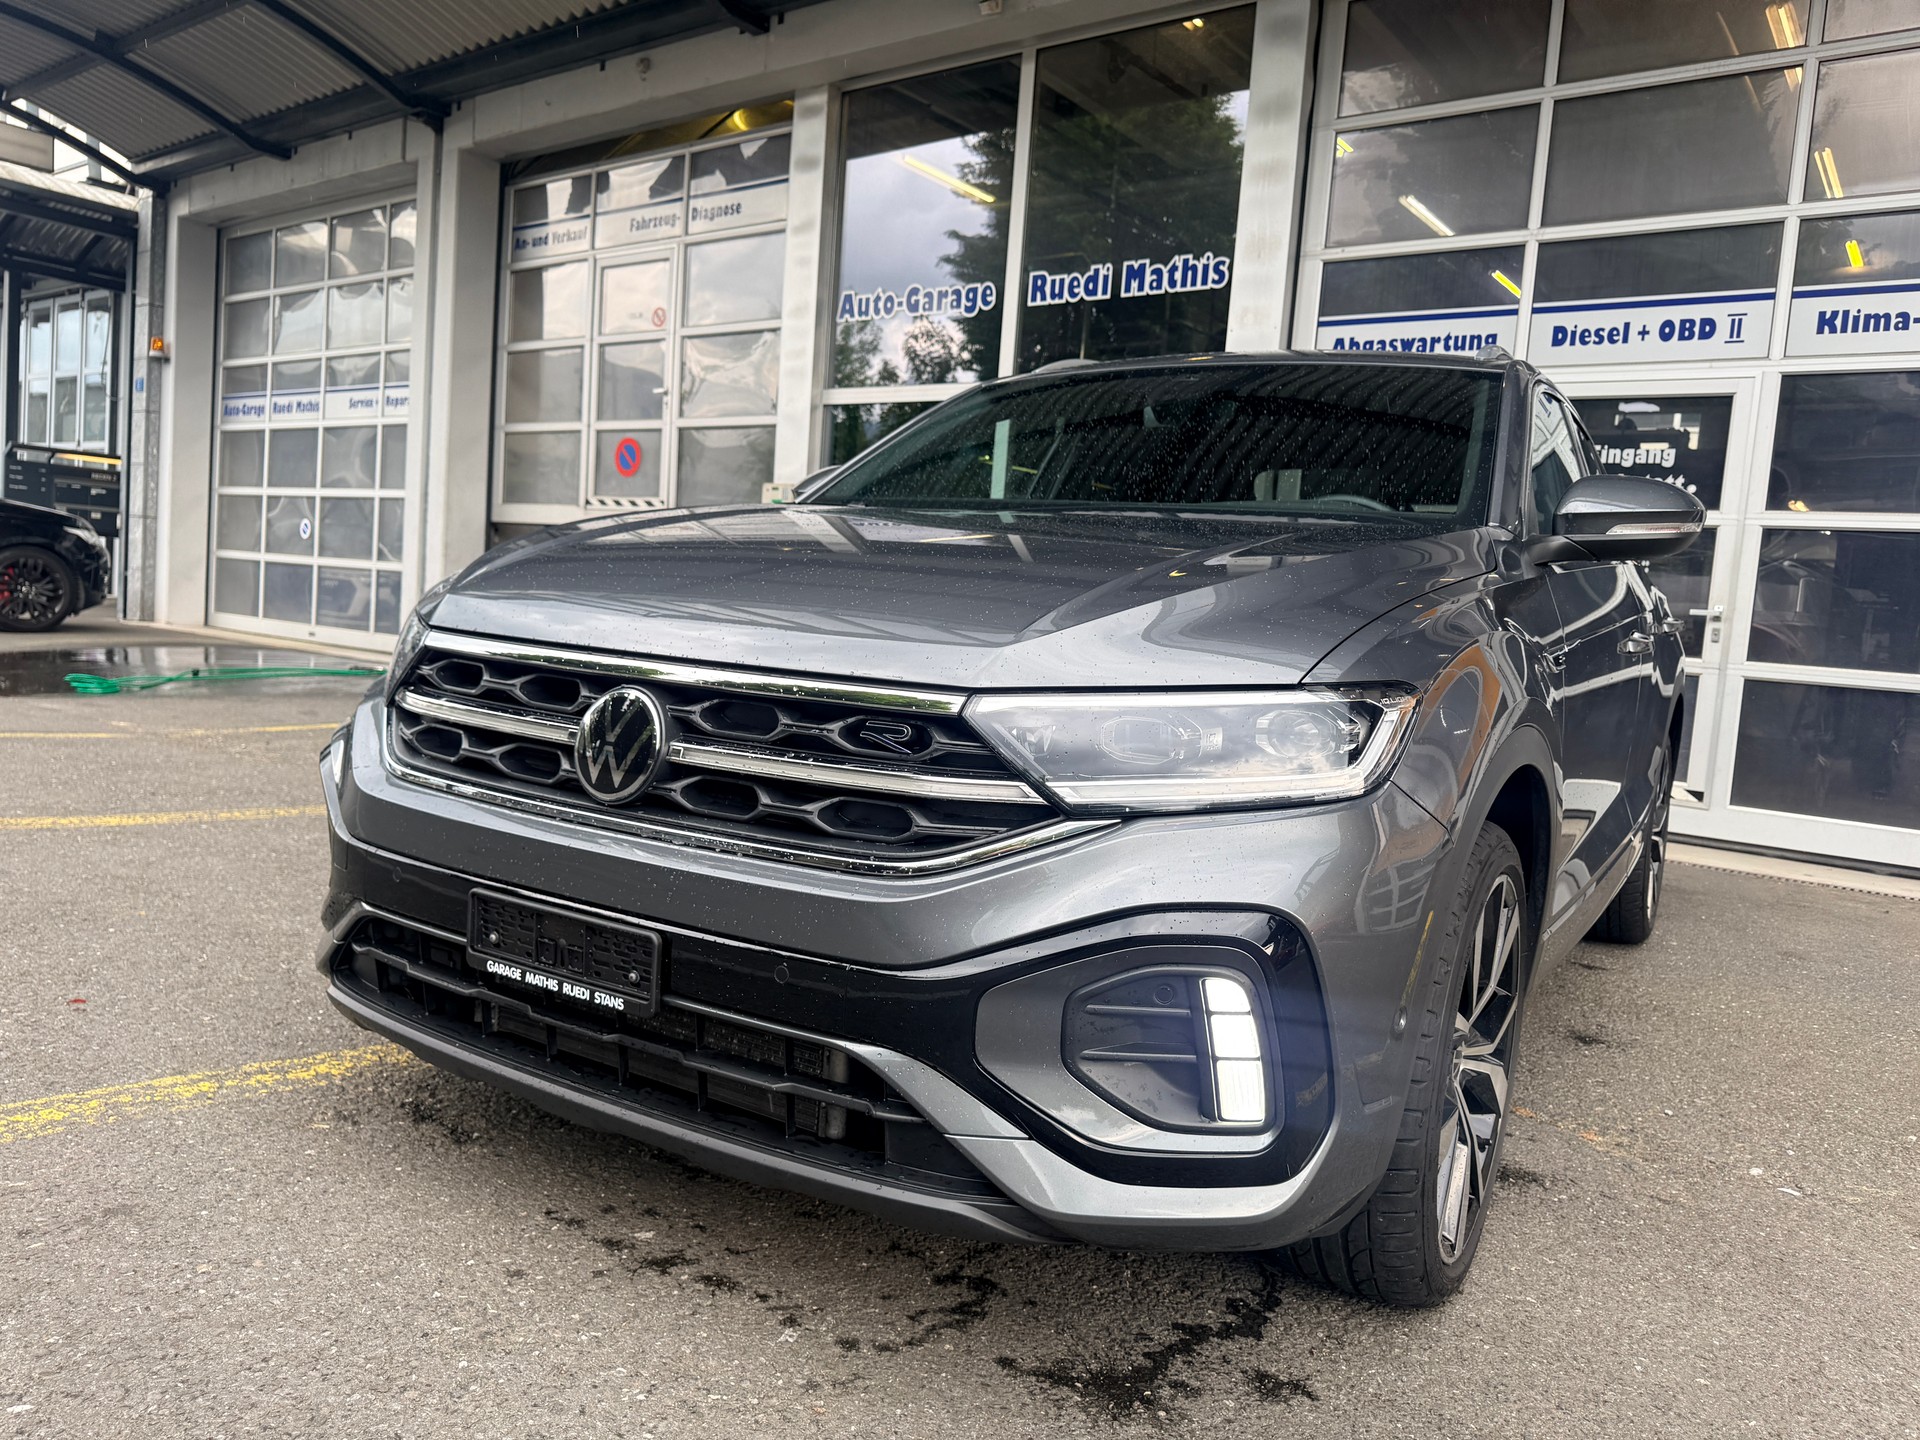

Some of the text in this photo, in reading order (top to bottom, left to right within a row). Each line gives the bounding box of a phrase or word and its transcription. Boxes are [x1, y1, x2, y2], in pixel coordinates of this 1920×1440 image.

[629, 201, 742, 233] Fahrzeug- Diagnose
[514, 224, 588, 250] An- und Verkauf
[836, 251, 1230, 322] Auto-Garage Ruedi Mathis
[1551, 321, 1631, 347] Diesel
[1637, 324, 1650, 342] +
[1658, 317, 1717, 342] OBD
[1815, 308, 1920, 335] Klima-
[486, 960, 624, 1010] GARAGE MATHIS RUEDI STANS
